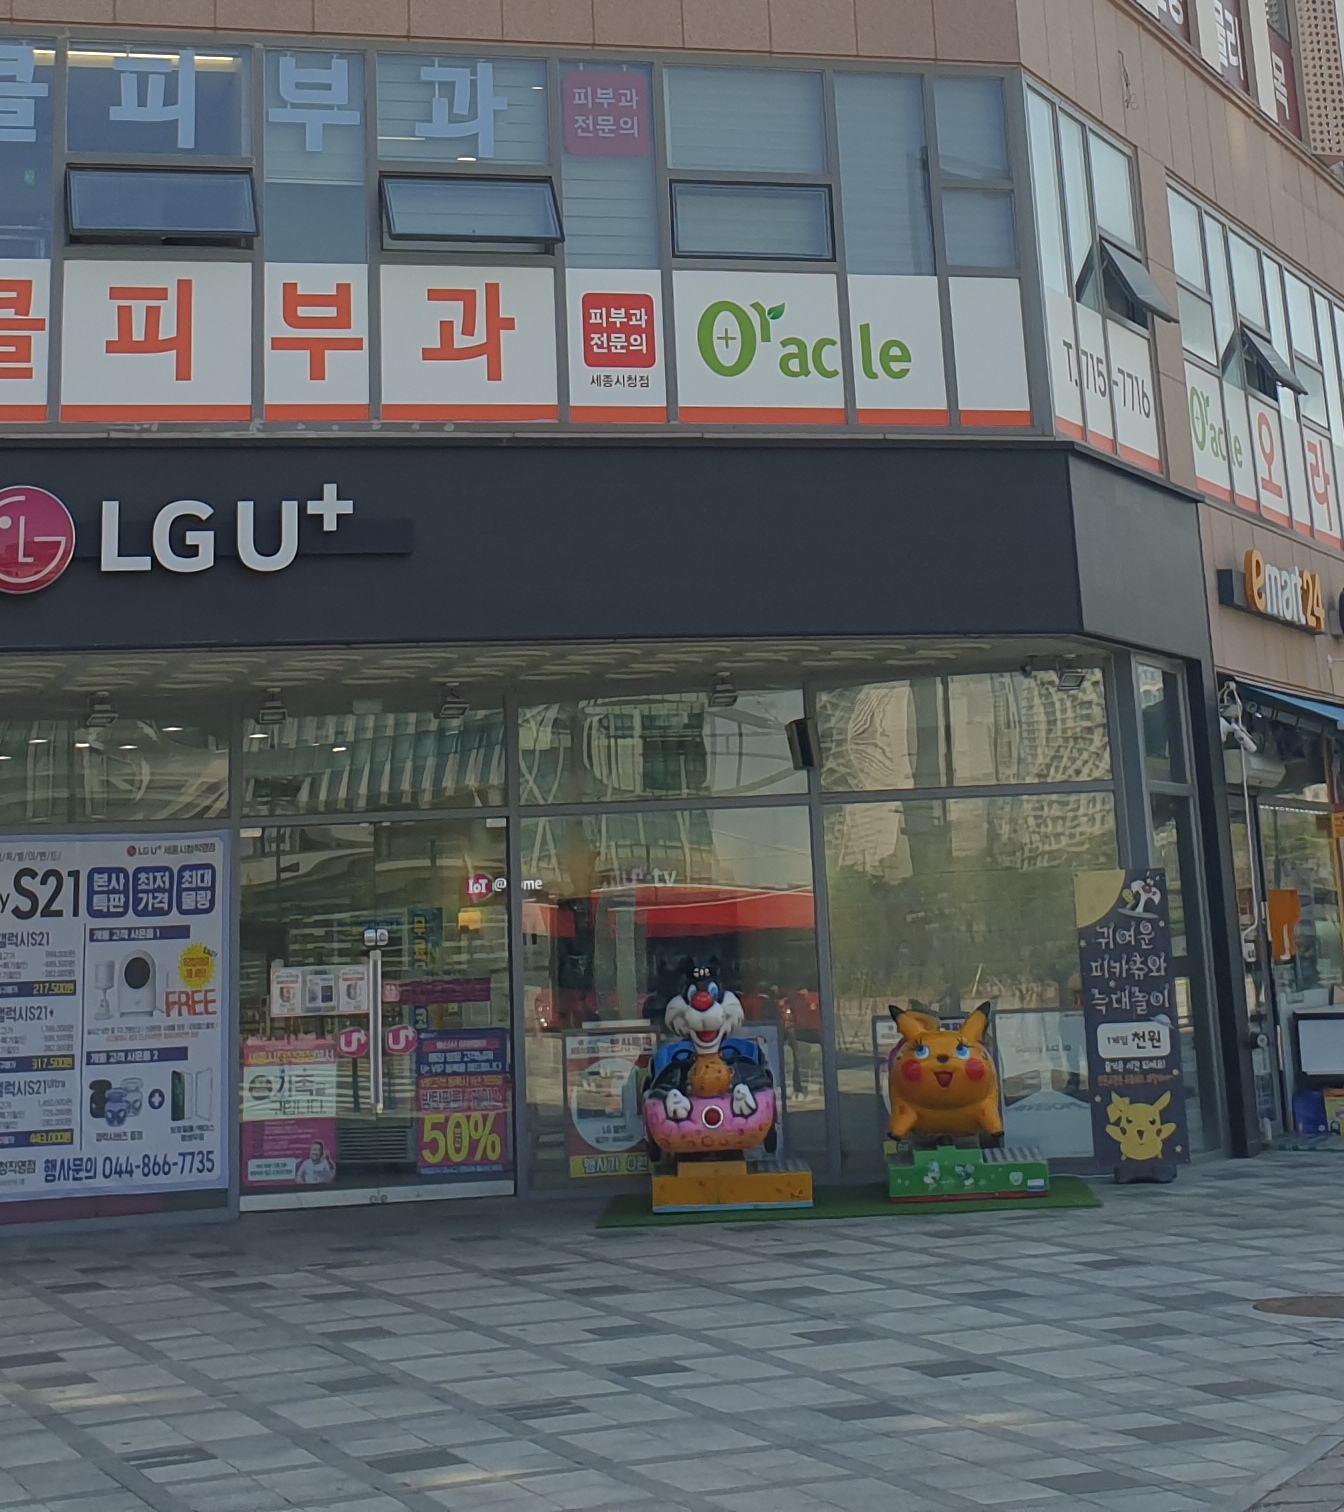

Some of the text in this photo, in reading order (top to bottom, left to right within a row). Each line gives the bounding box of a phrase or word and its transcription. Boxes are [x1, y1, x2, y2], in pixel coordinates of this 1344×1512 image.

[573, 86, 639, 111] 피부과
[573, 114, 639, 138] 전문의
[588, 306, 648, 329] 피부과
[588, 332, 648, 356] 전문의
[696, 300, 912, 380] Oracle
[589, 372, 651, 390] 세종시청점
[1062, 338, 1152, 420] T.715-7716
[1244, 547, 1326, 634] emart24
[92, 868, 213, 891] 본사 최저 최대
[468, 877, 488, 894] IoT
[10, 867, 81, 921] S21
[92, 889, 212, 914] 특판 가격 물량
[1095, 920, 1156, 950] 귀여운
[1090, 952, 1168, 981] 피카츄와
[165, 988, 218, 1018] FREE
[1131, 1029, 1162, 1050] 천원
[421, 1112, 502, 1164] 50%
[44, 1156, 98, 1183] 행사문의
[102, 1150, 216, 1180] 044-866-7735
